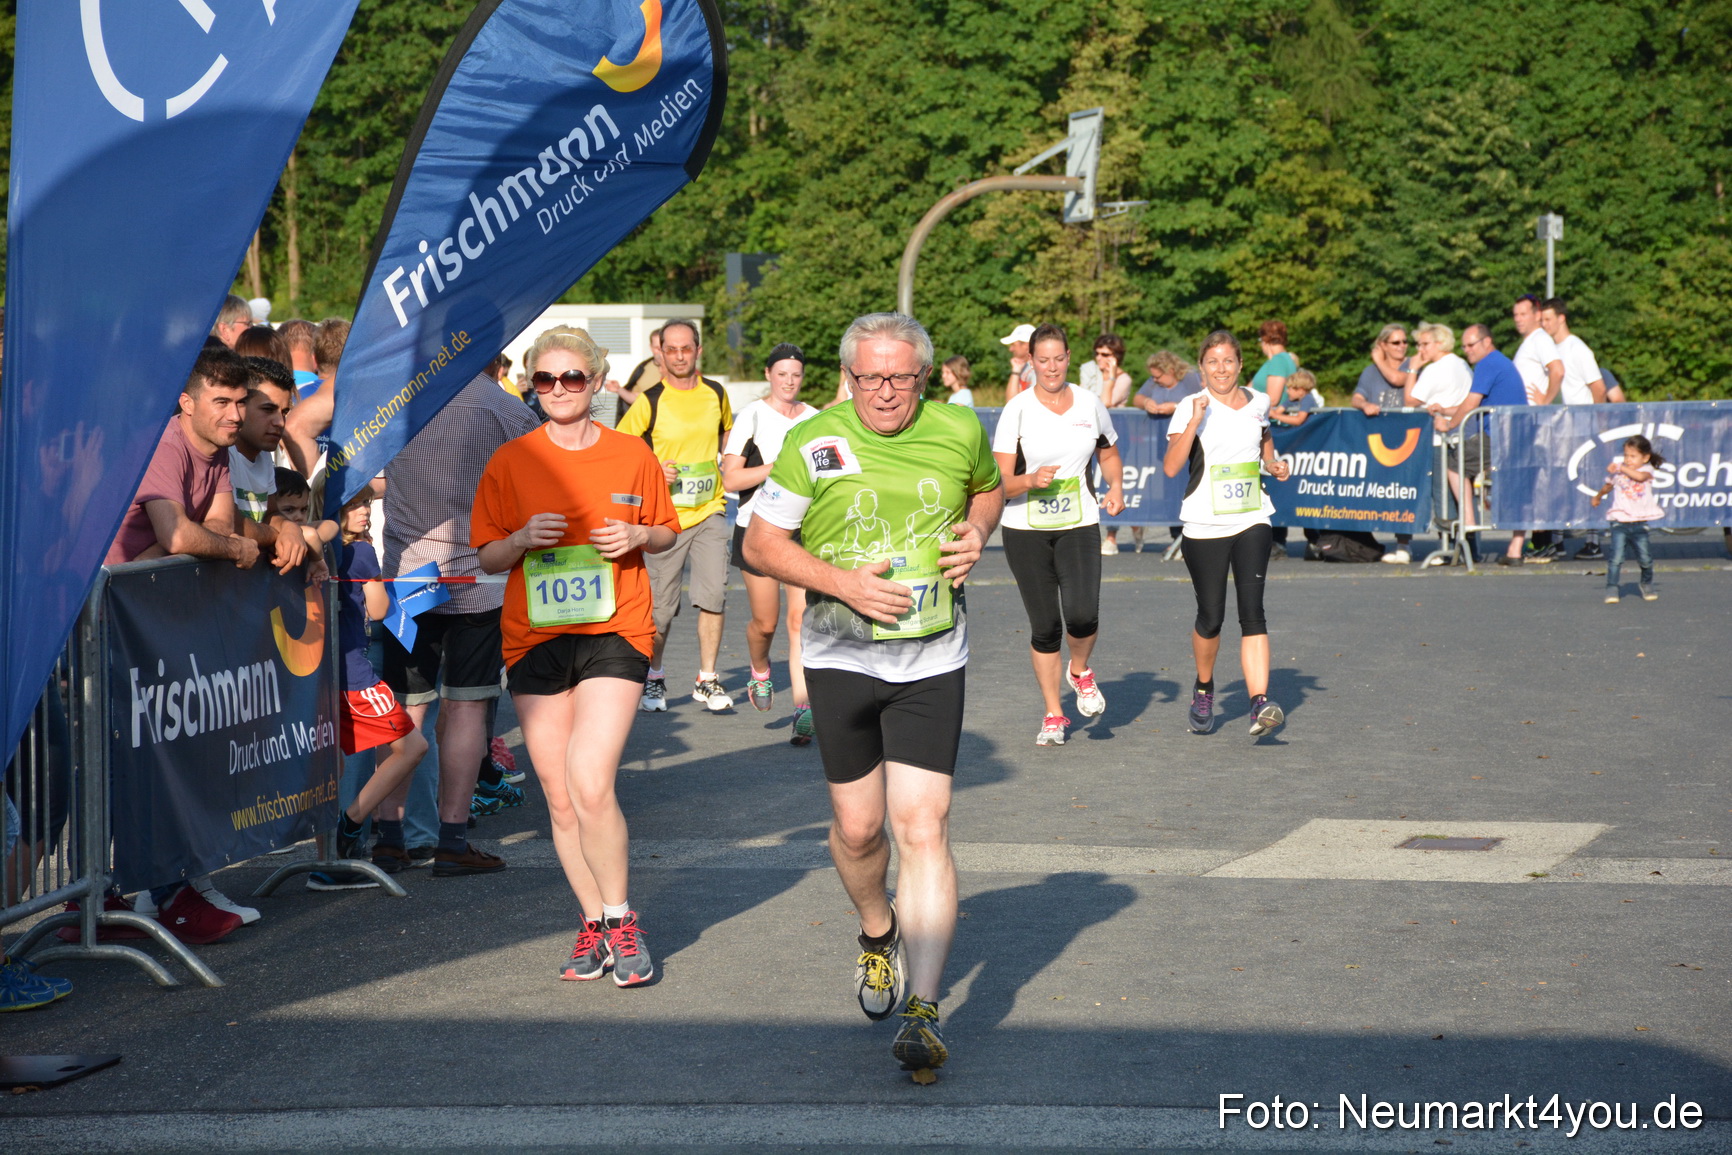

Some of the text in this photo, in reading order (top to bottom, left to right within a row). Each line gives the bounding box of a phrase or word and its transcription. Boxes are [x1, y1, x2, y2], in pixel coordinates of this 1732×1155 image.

[536, 77, 703, 235] Druck und Medien
[383, 104, 620, 328] Frischmann
[676, 478, 713, 494] 1290
[1223, 482, 1252, 499] 387
[1297, 479, 1417, 500] Druck und Medien
[1038, 497, 1071, 514] 392
[1295, 505, 1415, 523] www.frischmann-net.de
[536, 574, 602, 605] 1031
[130, 653, 281, 748] Frischmann
[229, 714, 335, 775] Druck und Medien
[231, 774, 337, 831] www.frischmann-net.de
